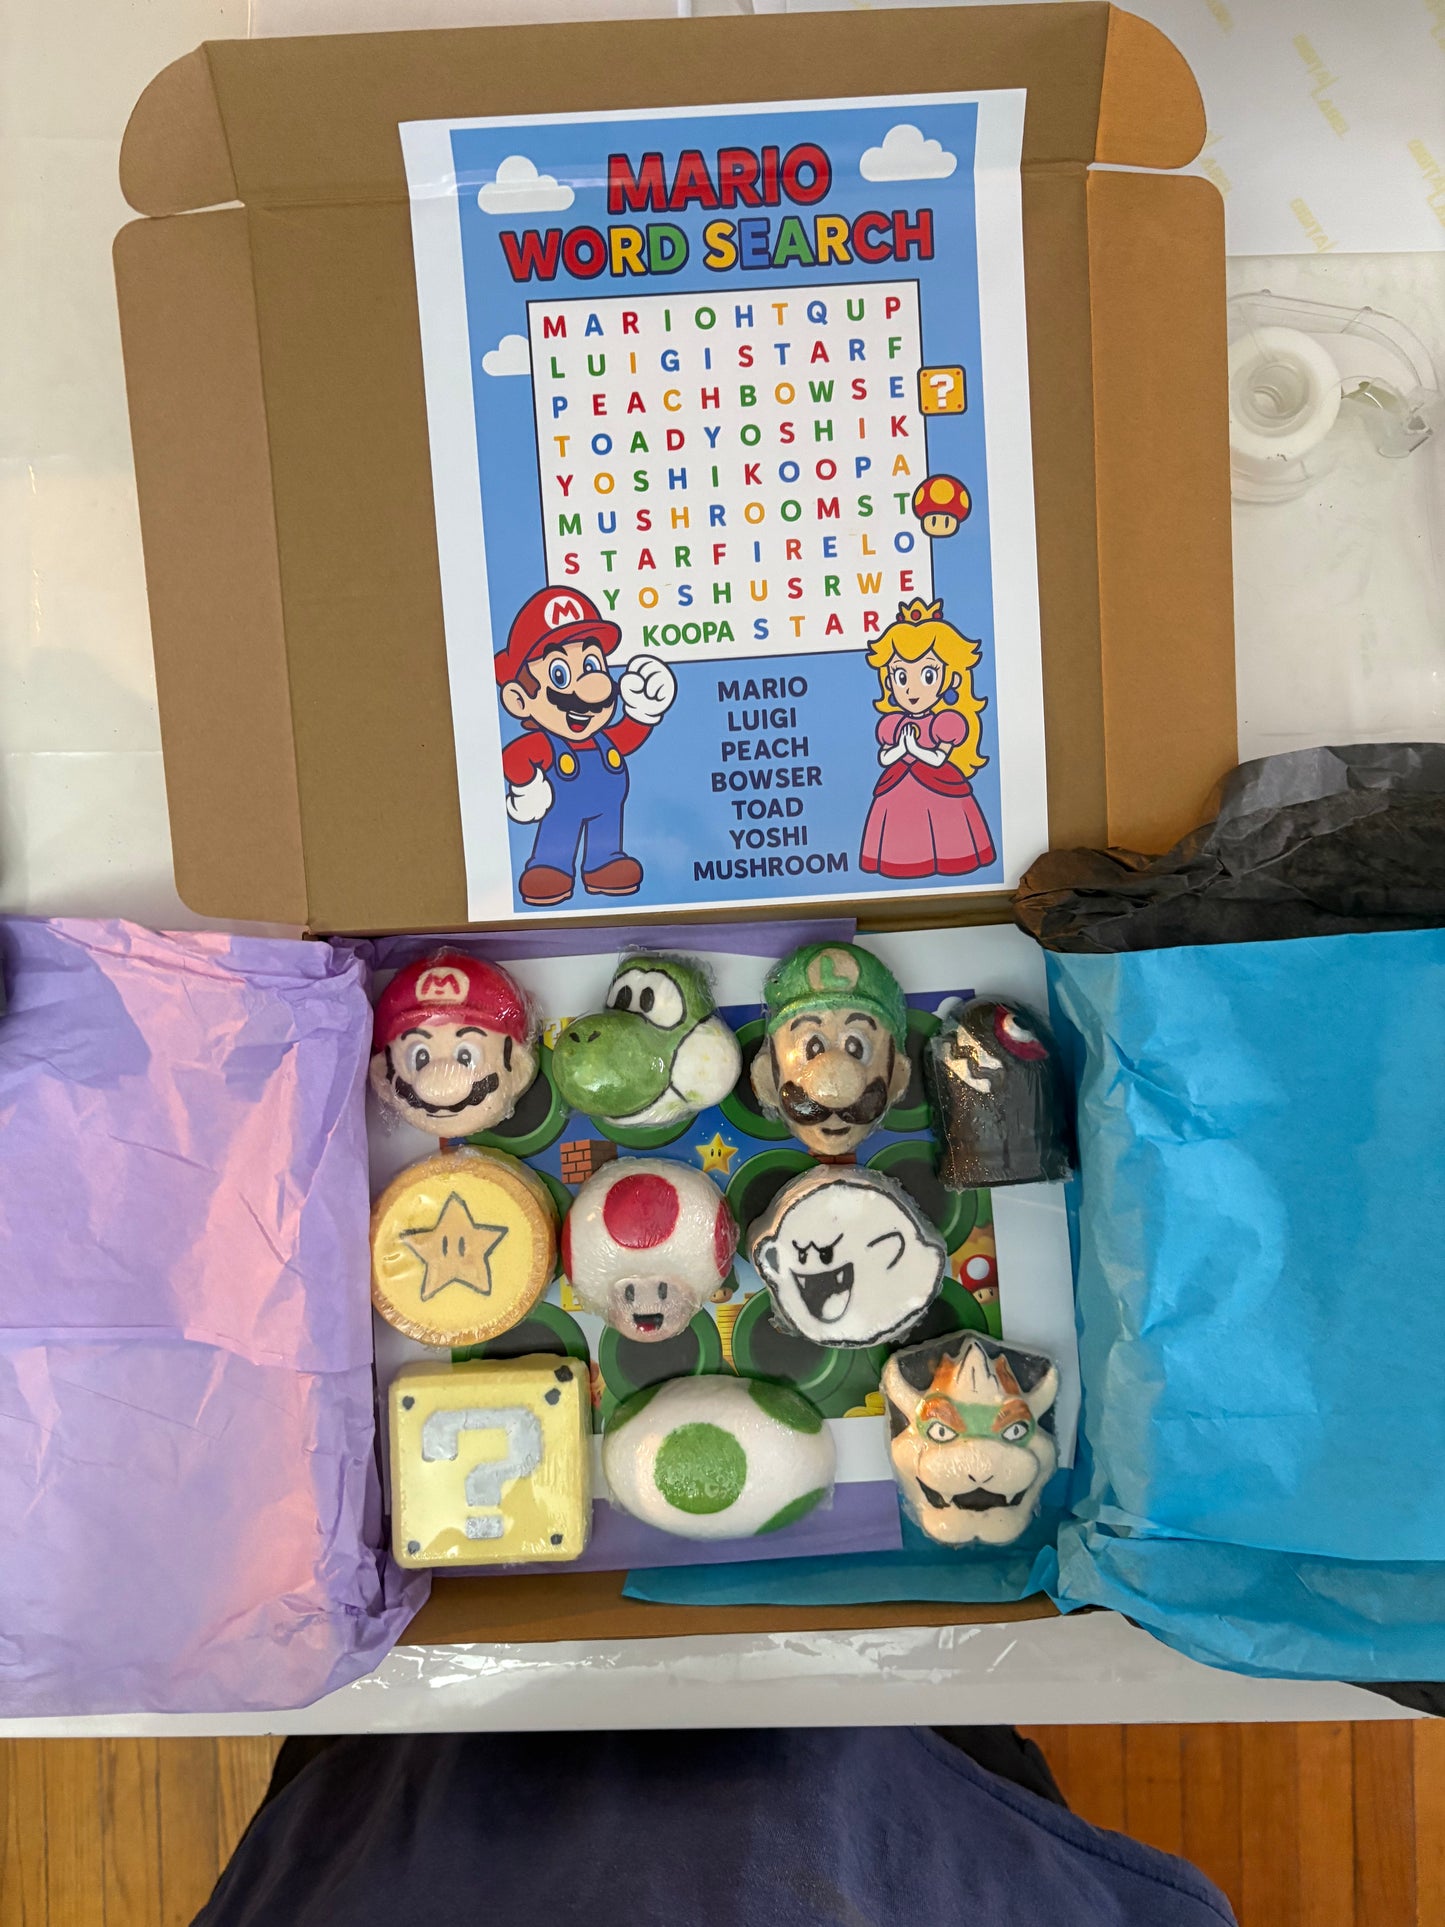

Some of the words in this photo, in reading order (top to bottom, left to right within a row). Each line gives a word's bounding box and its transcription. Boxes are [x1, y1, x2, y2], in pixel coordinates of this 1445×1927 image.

[607, 142, 832, 214] MARIO
[499, 222, 690, 282] WORD
[702, 208, 935, 272] SEARCH
[552, 600, 580, 625] M
[643, 620, 735, 647] KOOPA
[718, 676, 808, 702] MARIO
[727, 707, 797, 732] LUIGI
[721, 736, 809, 762] PEACH
[711, 766, 823, 792] BOWSER
[731, 797, 804, 820] TOAD
[729, 825, 808, 850] YOSHI
[693, 852, 848, 881] MUSHROOM
[421, 972, 460, 996] M
[820, 955, 850, 989] L
